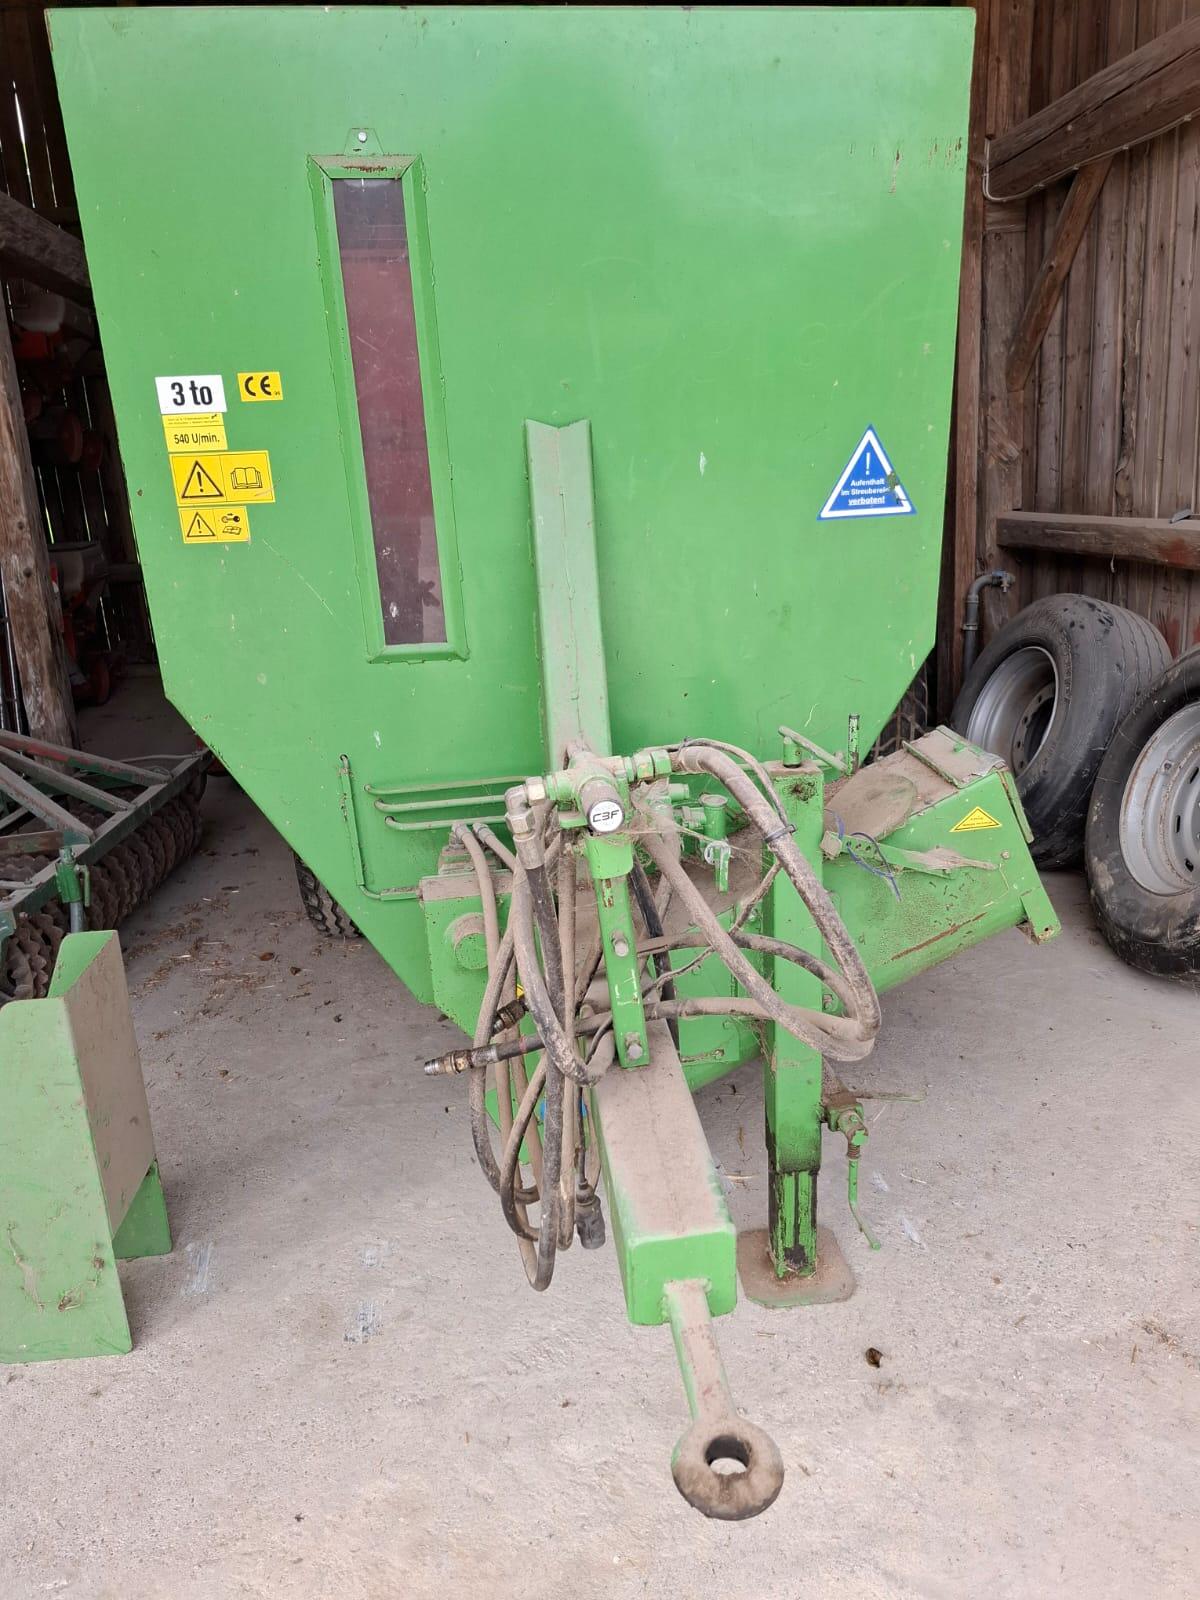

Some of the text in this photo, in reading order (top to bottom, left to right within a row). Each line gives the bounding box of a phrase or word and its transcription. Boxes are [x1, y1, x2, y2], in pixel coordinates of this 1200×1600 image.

[244, 375, 272, 396] CE
[171, 380, 213, 406] 3 to
[174, 432, 220, 445] 540 U/min.
[850, 478, 885, 487] Aufenthalt
[848, 496, 885, 505] verboten!
